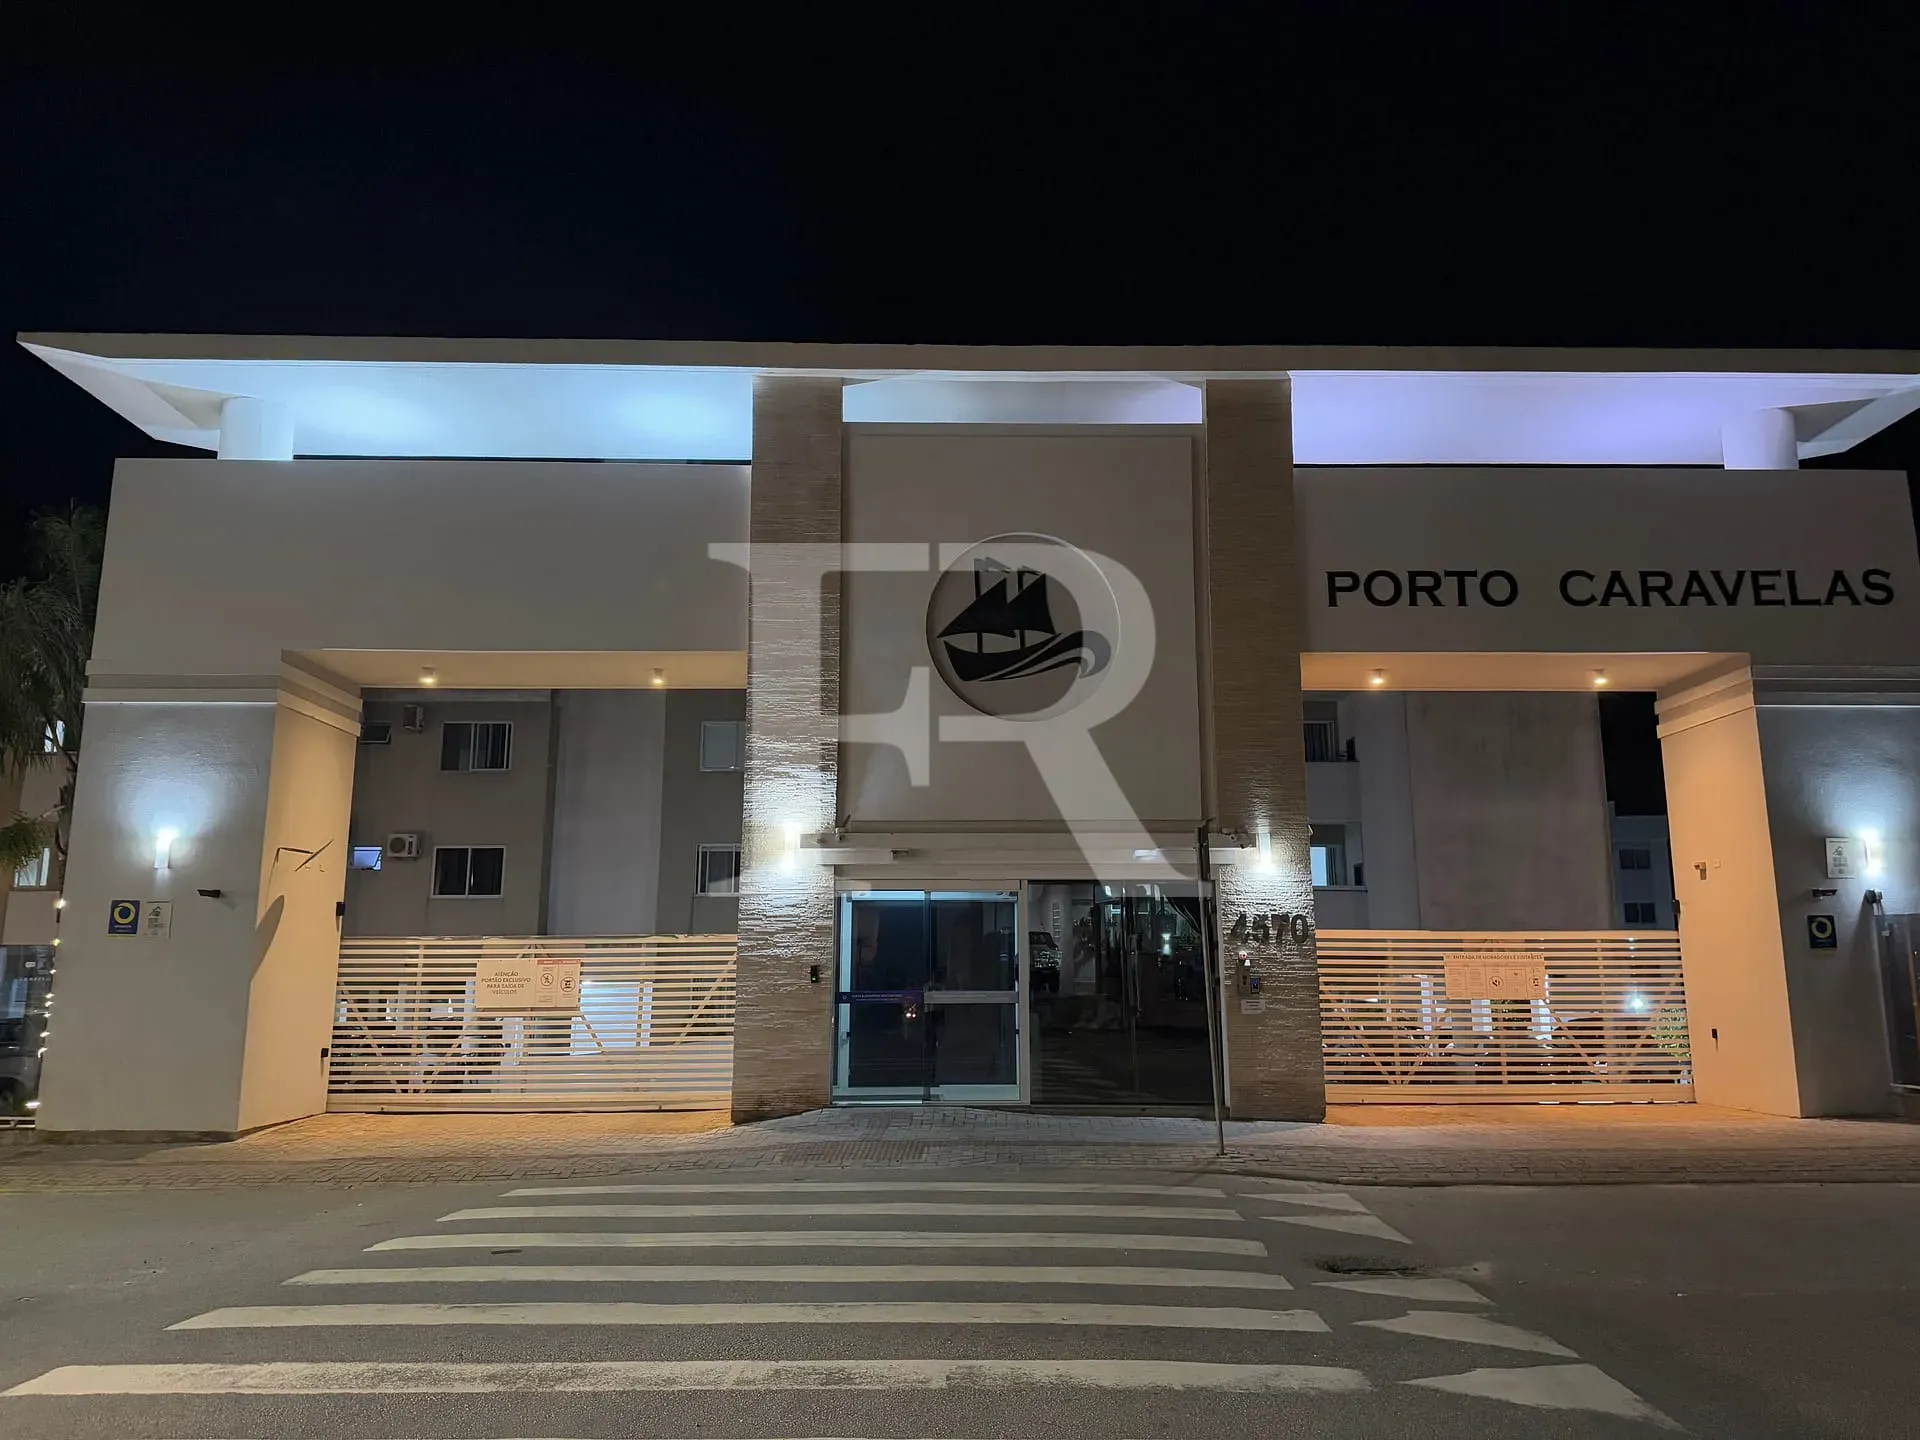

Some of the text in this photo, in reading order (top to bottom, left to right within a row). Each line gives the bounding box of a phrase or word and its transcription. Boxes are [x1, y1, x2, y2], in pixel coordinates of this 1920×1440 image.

[1326, 568, 1895, 607] PORTO CARAVELAS
[1231, 913, 1310, 943] 4570
